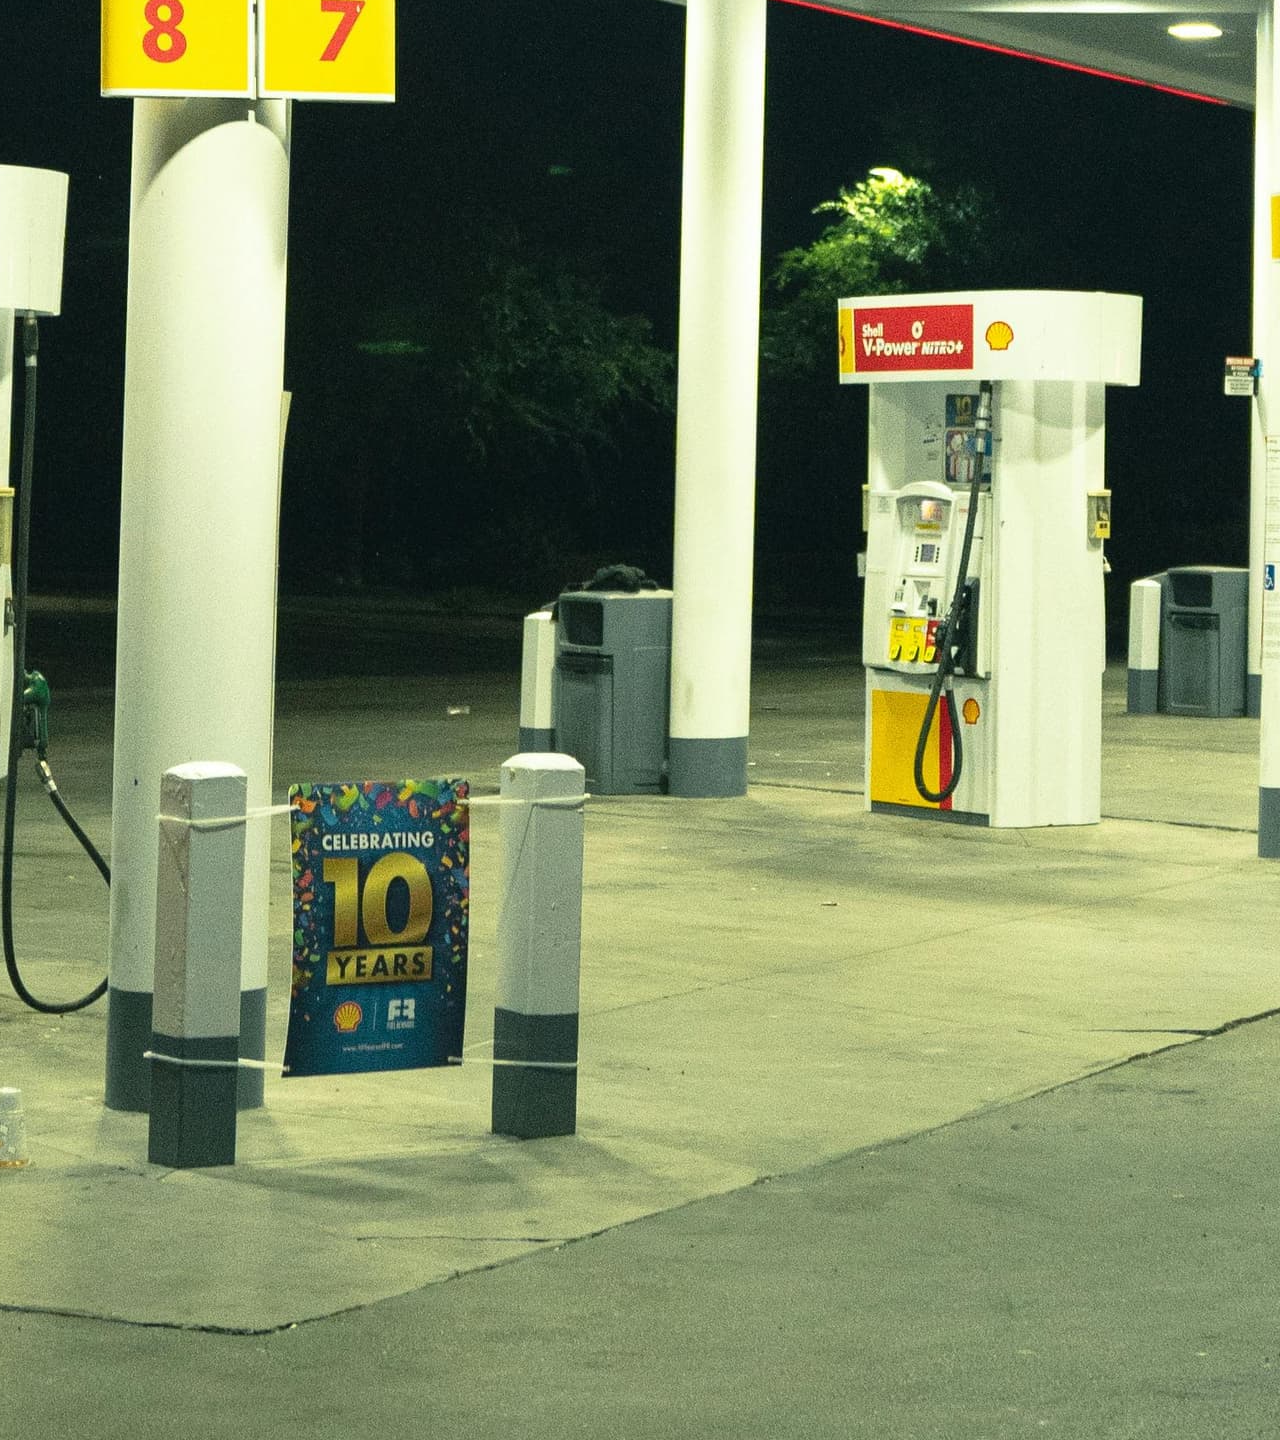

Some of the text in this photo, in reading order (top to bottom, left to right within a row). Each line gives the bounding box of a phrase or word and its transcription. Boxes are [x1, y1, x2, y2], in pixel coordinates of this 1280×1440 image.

[320, 0, 366, 61] 7
[862, 323, 883, 337] Shell
[862, 338, 919, 356] V-Power
[921, 340, 964, 356] NITRO+
[322, 831, 434, 851] CELEBRATING
[323, 852, 433, 948] 10
[335, 952, 425, 979] YEARS
